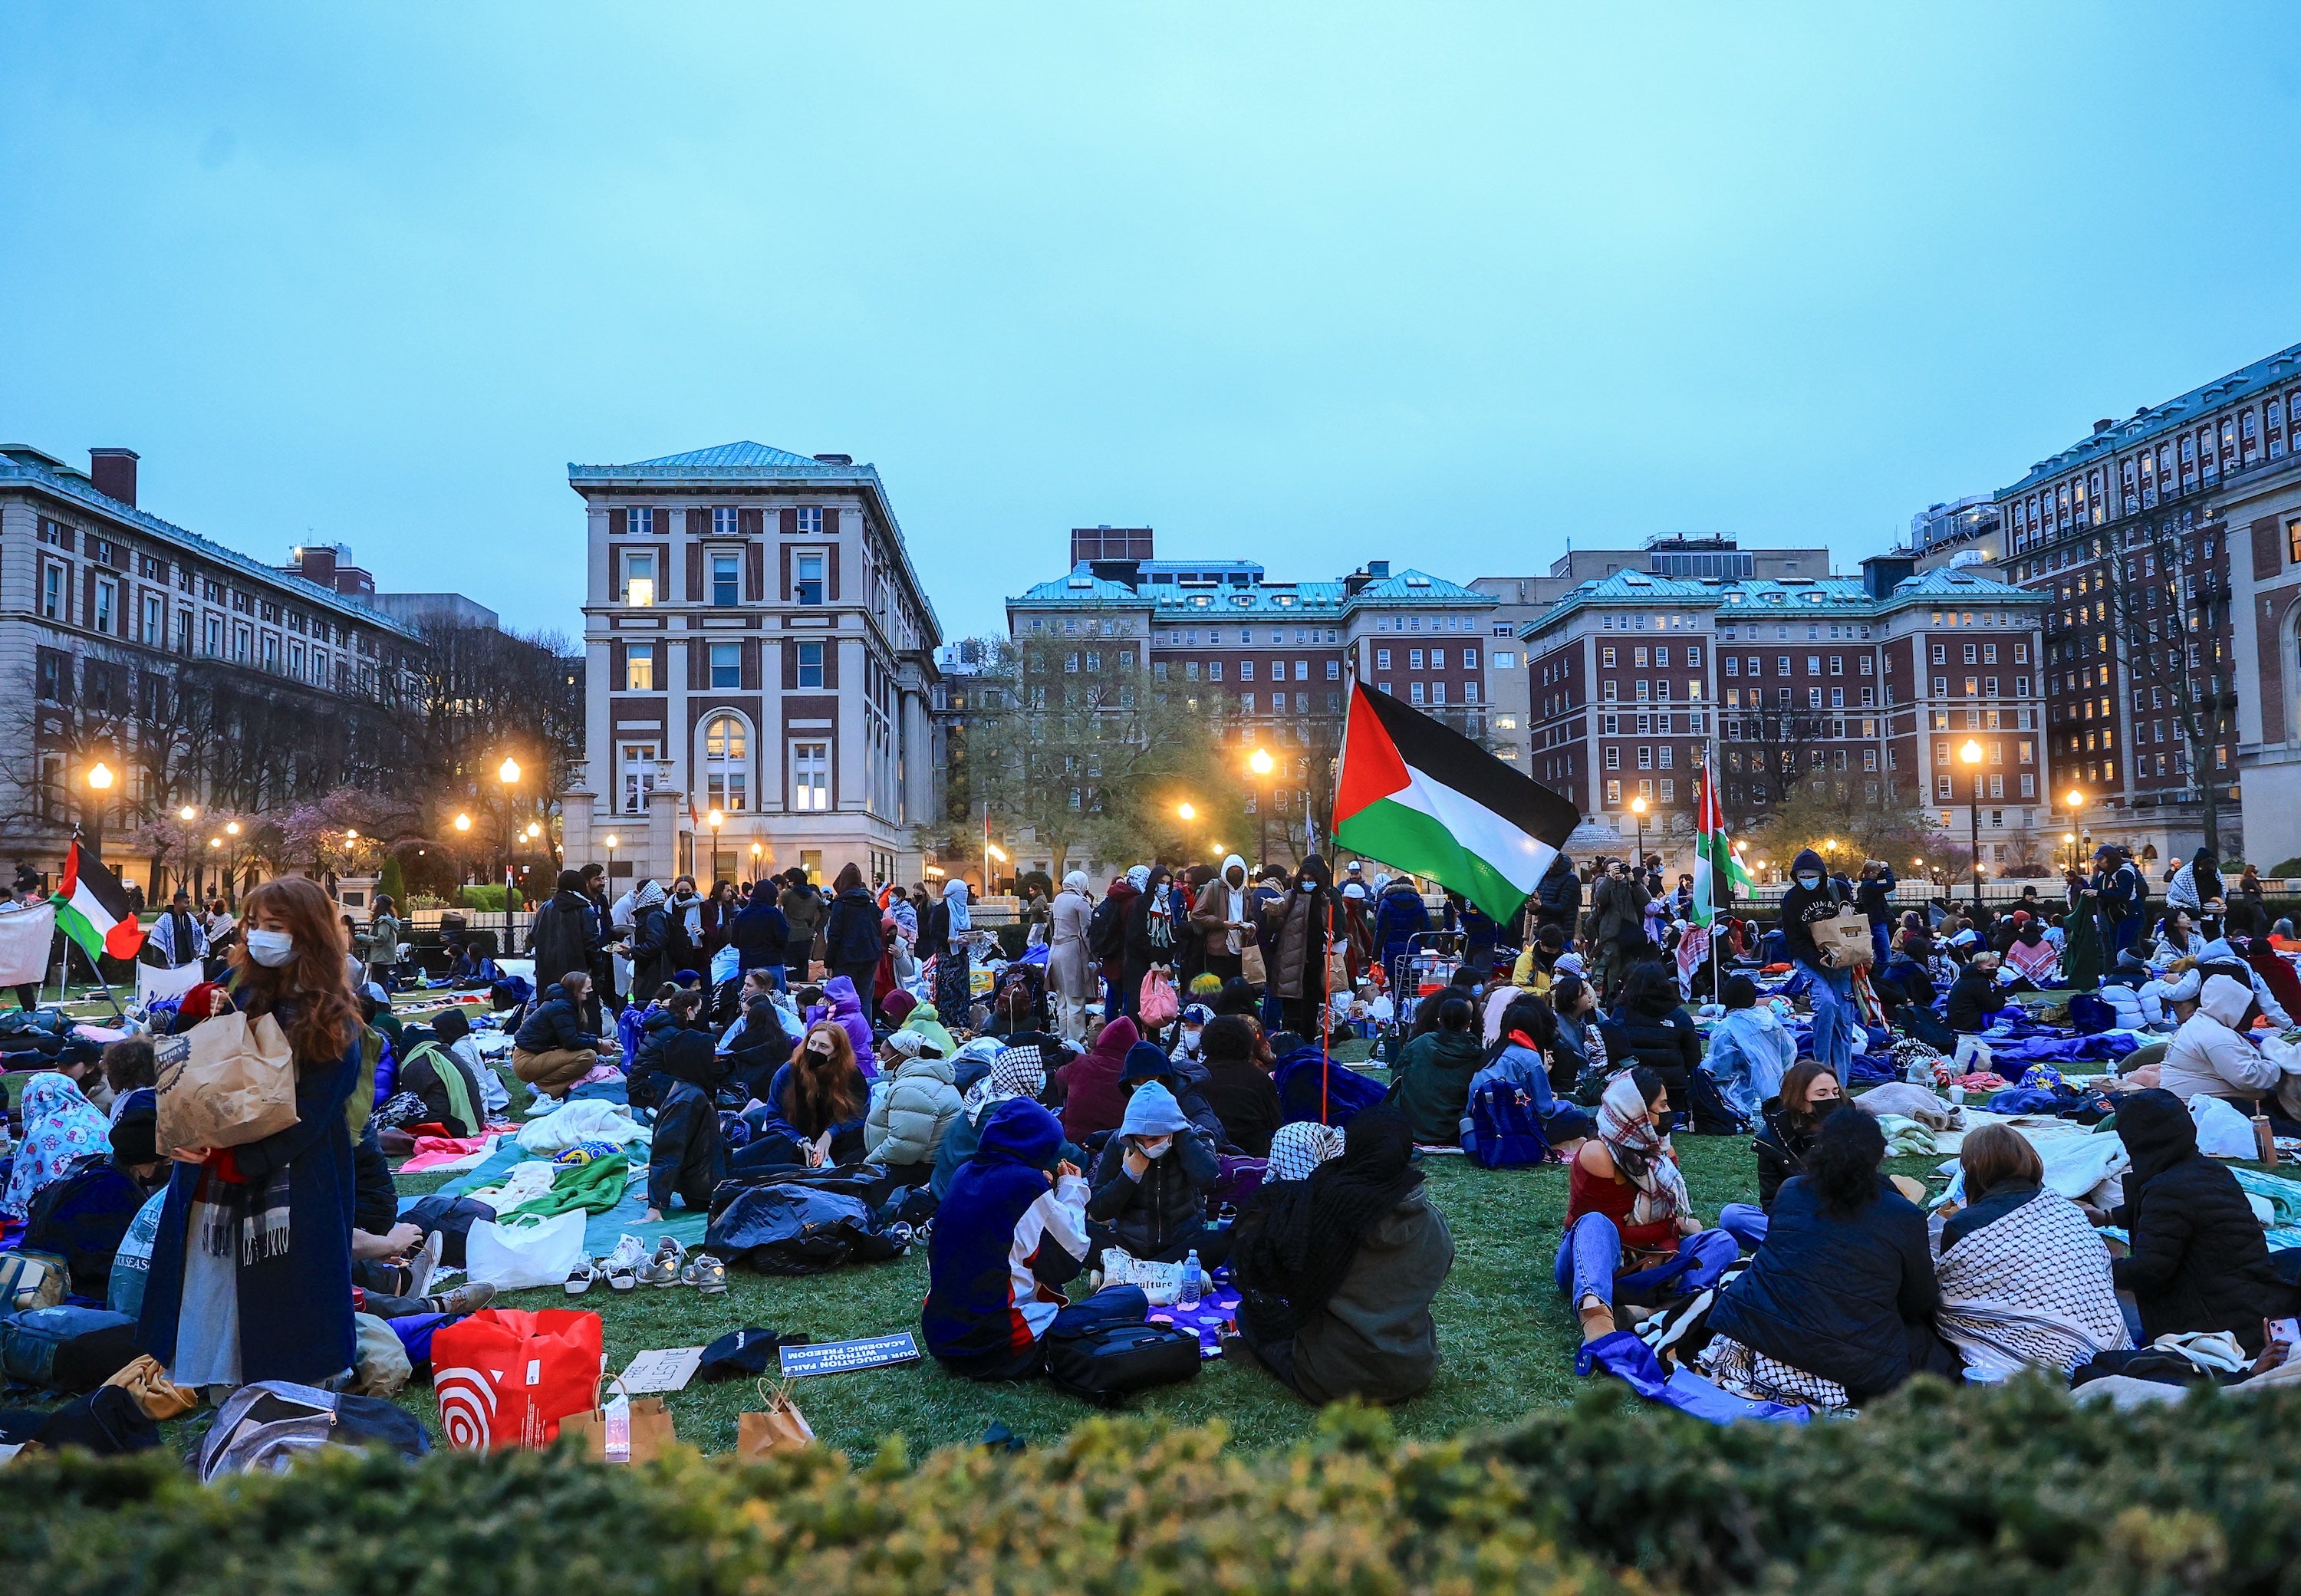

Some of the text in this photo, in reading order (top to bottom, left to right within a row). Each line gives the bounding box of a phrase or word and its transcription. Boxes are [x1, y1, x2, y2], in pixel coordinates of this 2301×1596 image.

[787, 1339, 907, 1360] ACADEMIC FREEDOM
[821, 1350, 877, 1361] WITHOUT
[641, 1350, 690, 1390] PALESTINE
[783, 1350, 917, 1373] OUR EDUCATION FAILS
